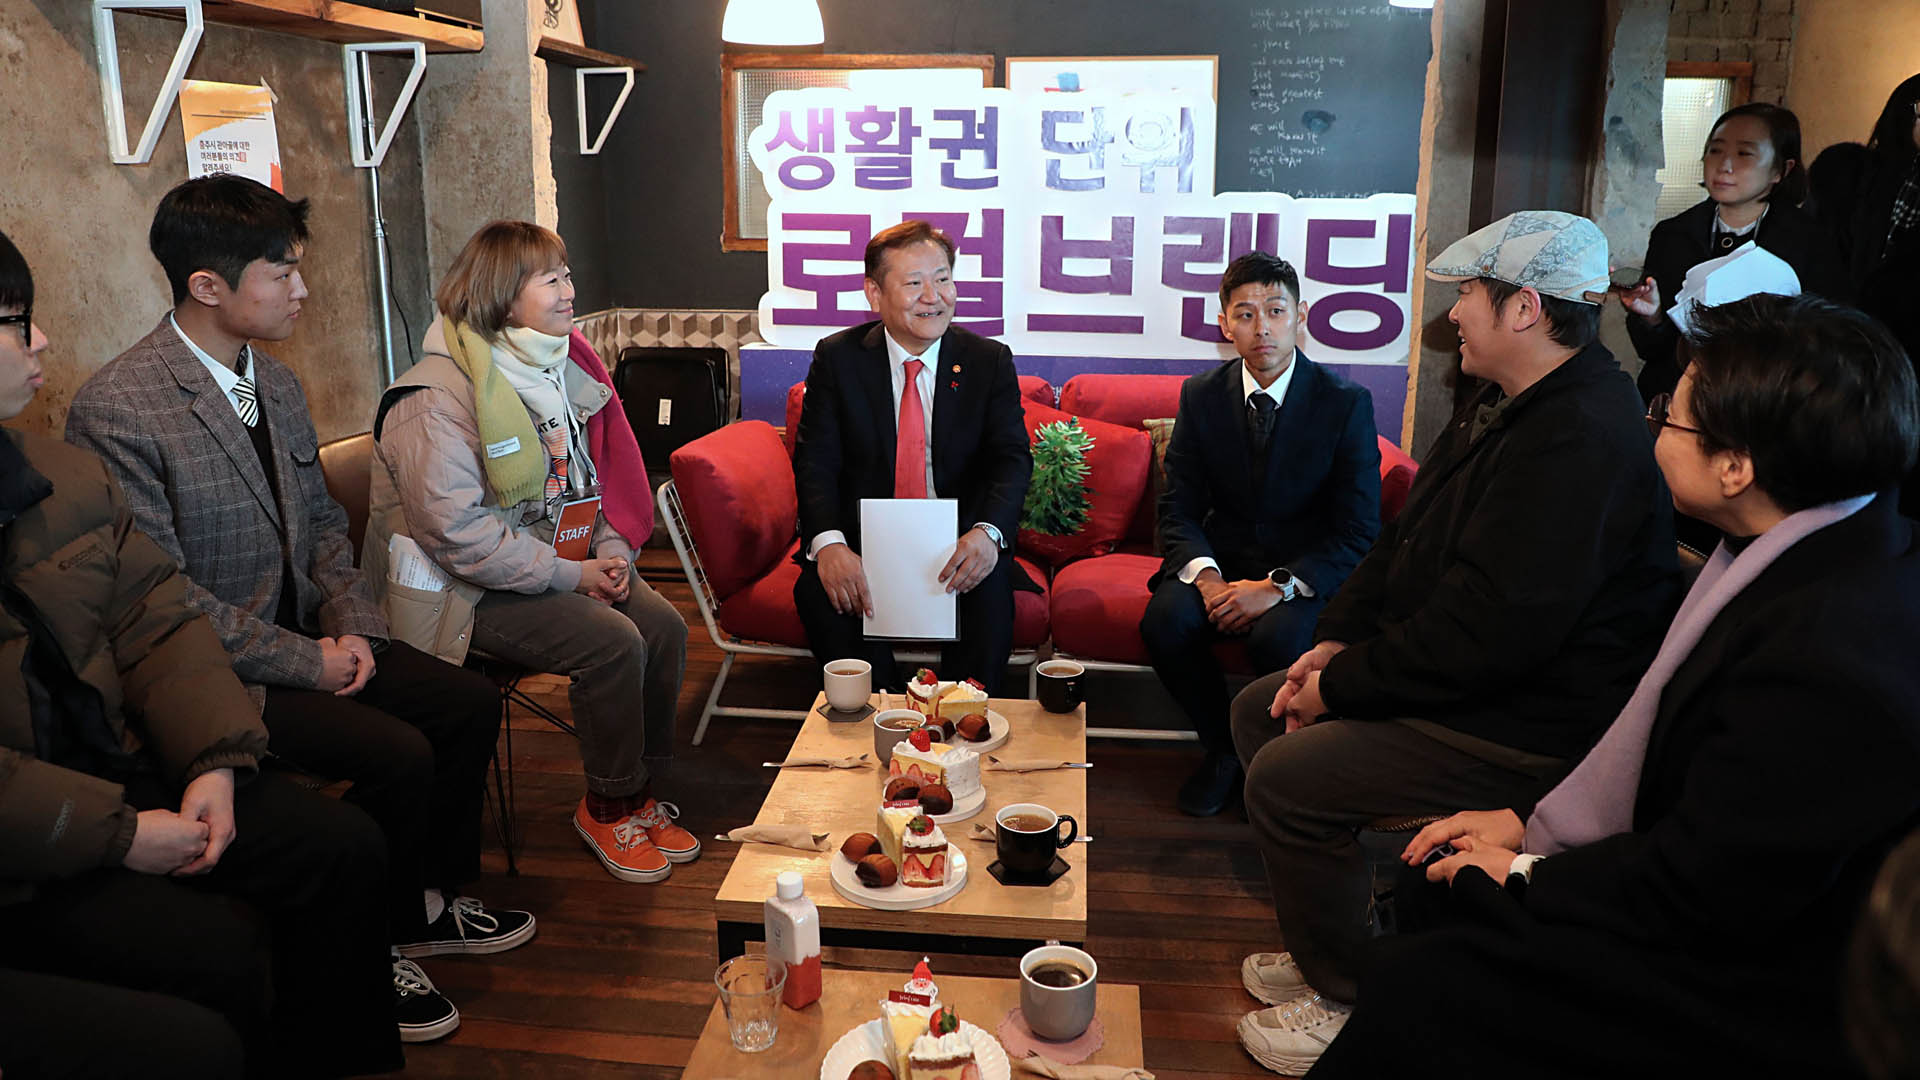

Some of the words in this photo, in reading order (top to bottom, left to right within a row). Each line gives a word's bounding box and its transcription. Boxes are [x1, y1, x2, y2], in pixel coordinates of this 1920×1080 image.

[239, 141, 250, 151] 대한
[765, 105, 999, 191] 생활권
[1041, 106, 1195, 193] 단위
[558, 525, 591, 543] STAFF
